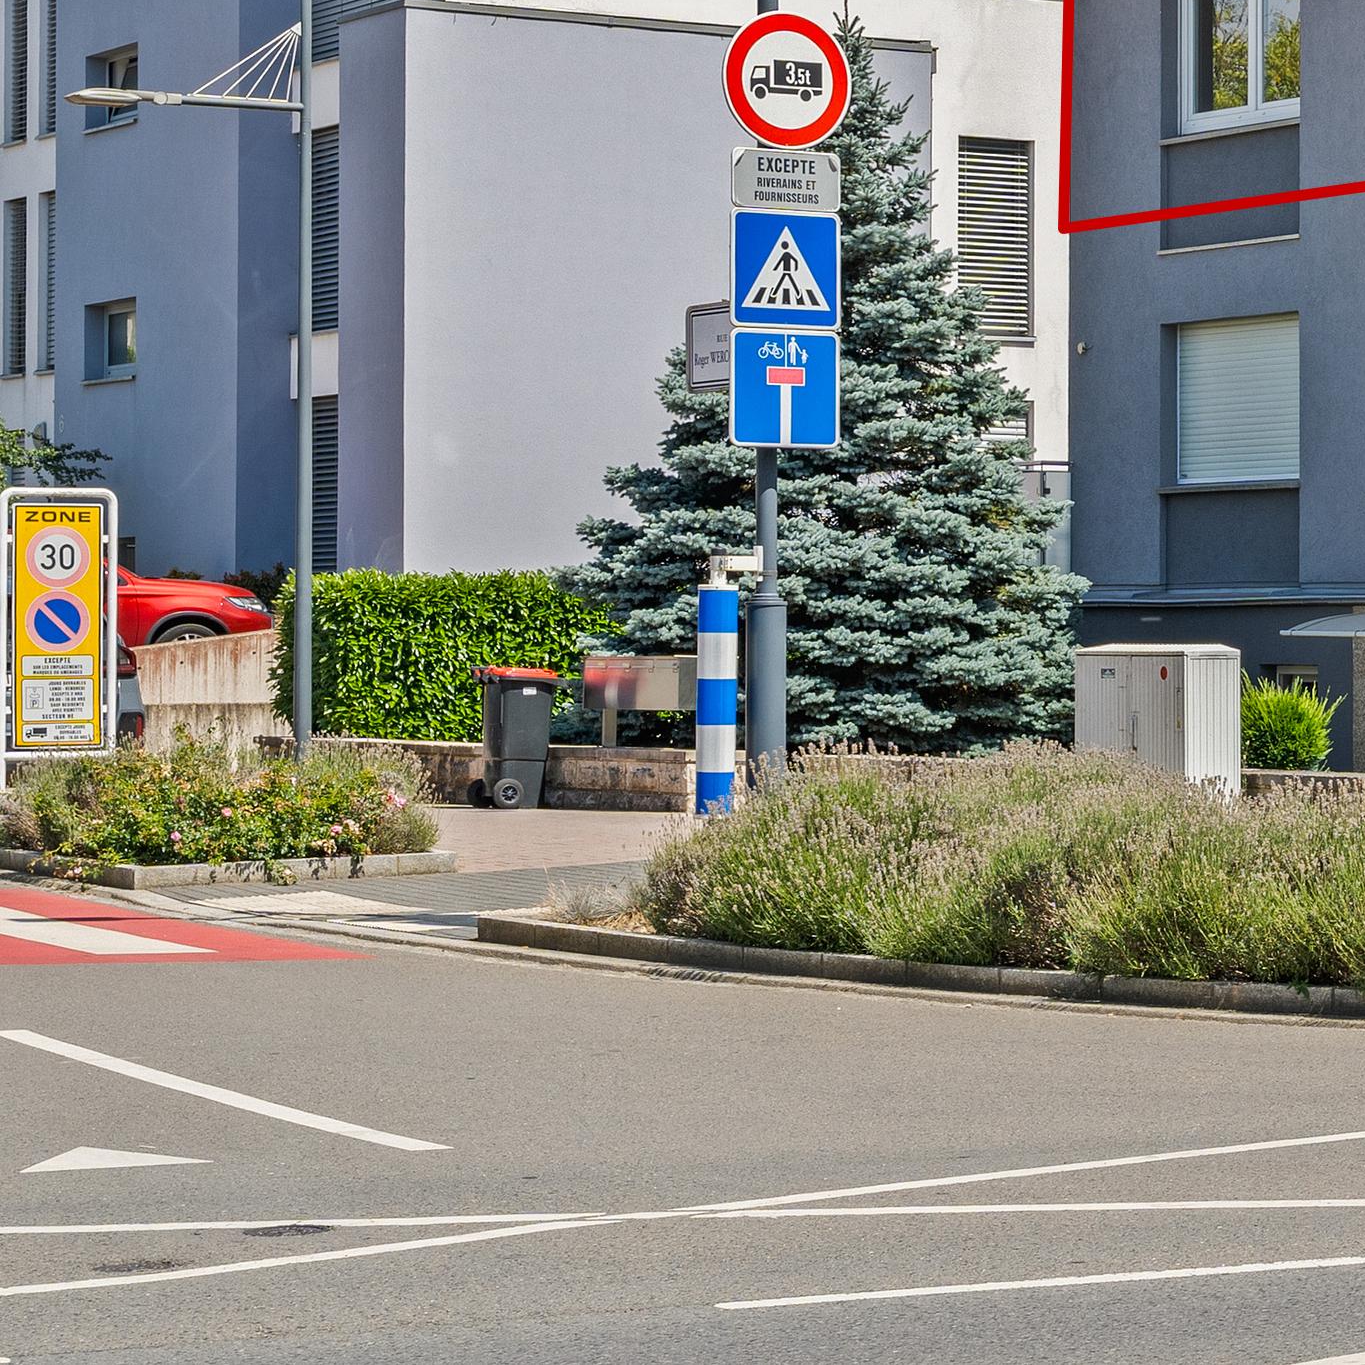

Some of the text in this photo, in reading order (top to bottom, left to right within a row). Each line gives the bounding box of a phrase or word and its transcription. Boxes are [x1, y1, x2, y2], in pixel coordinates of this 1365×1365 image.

[785, 62, 811, 85] 3,5t
[757, 156, 816, 174] EXCEPTE
[756, 177, 816, 190] RIVERAINS ET
[754, 190, 819, 205] FOURNISSEURS
[716, 333, 728, 343] RUE
[694, 353, 710, 368] Roger
[25, 511, 91, 523] ZONE
[40, 543, 75, 570] 30
